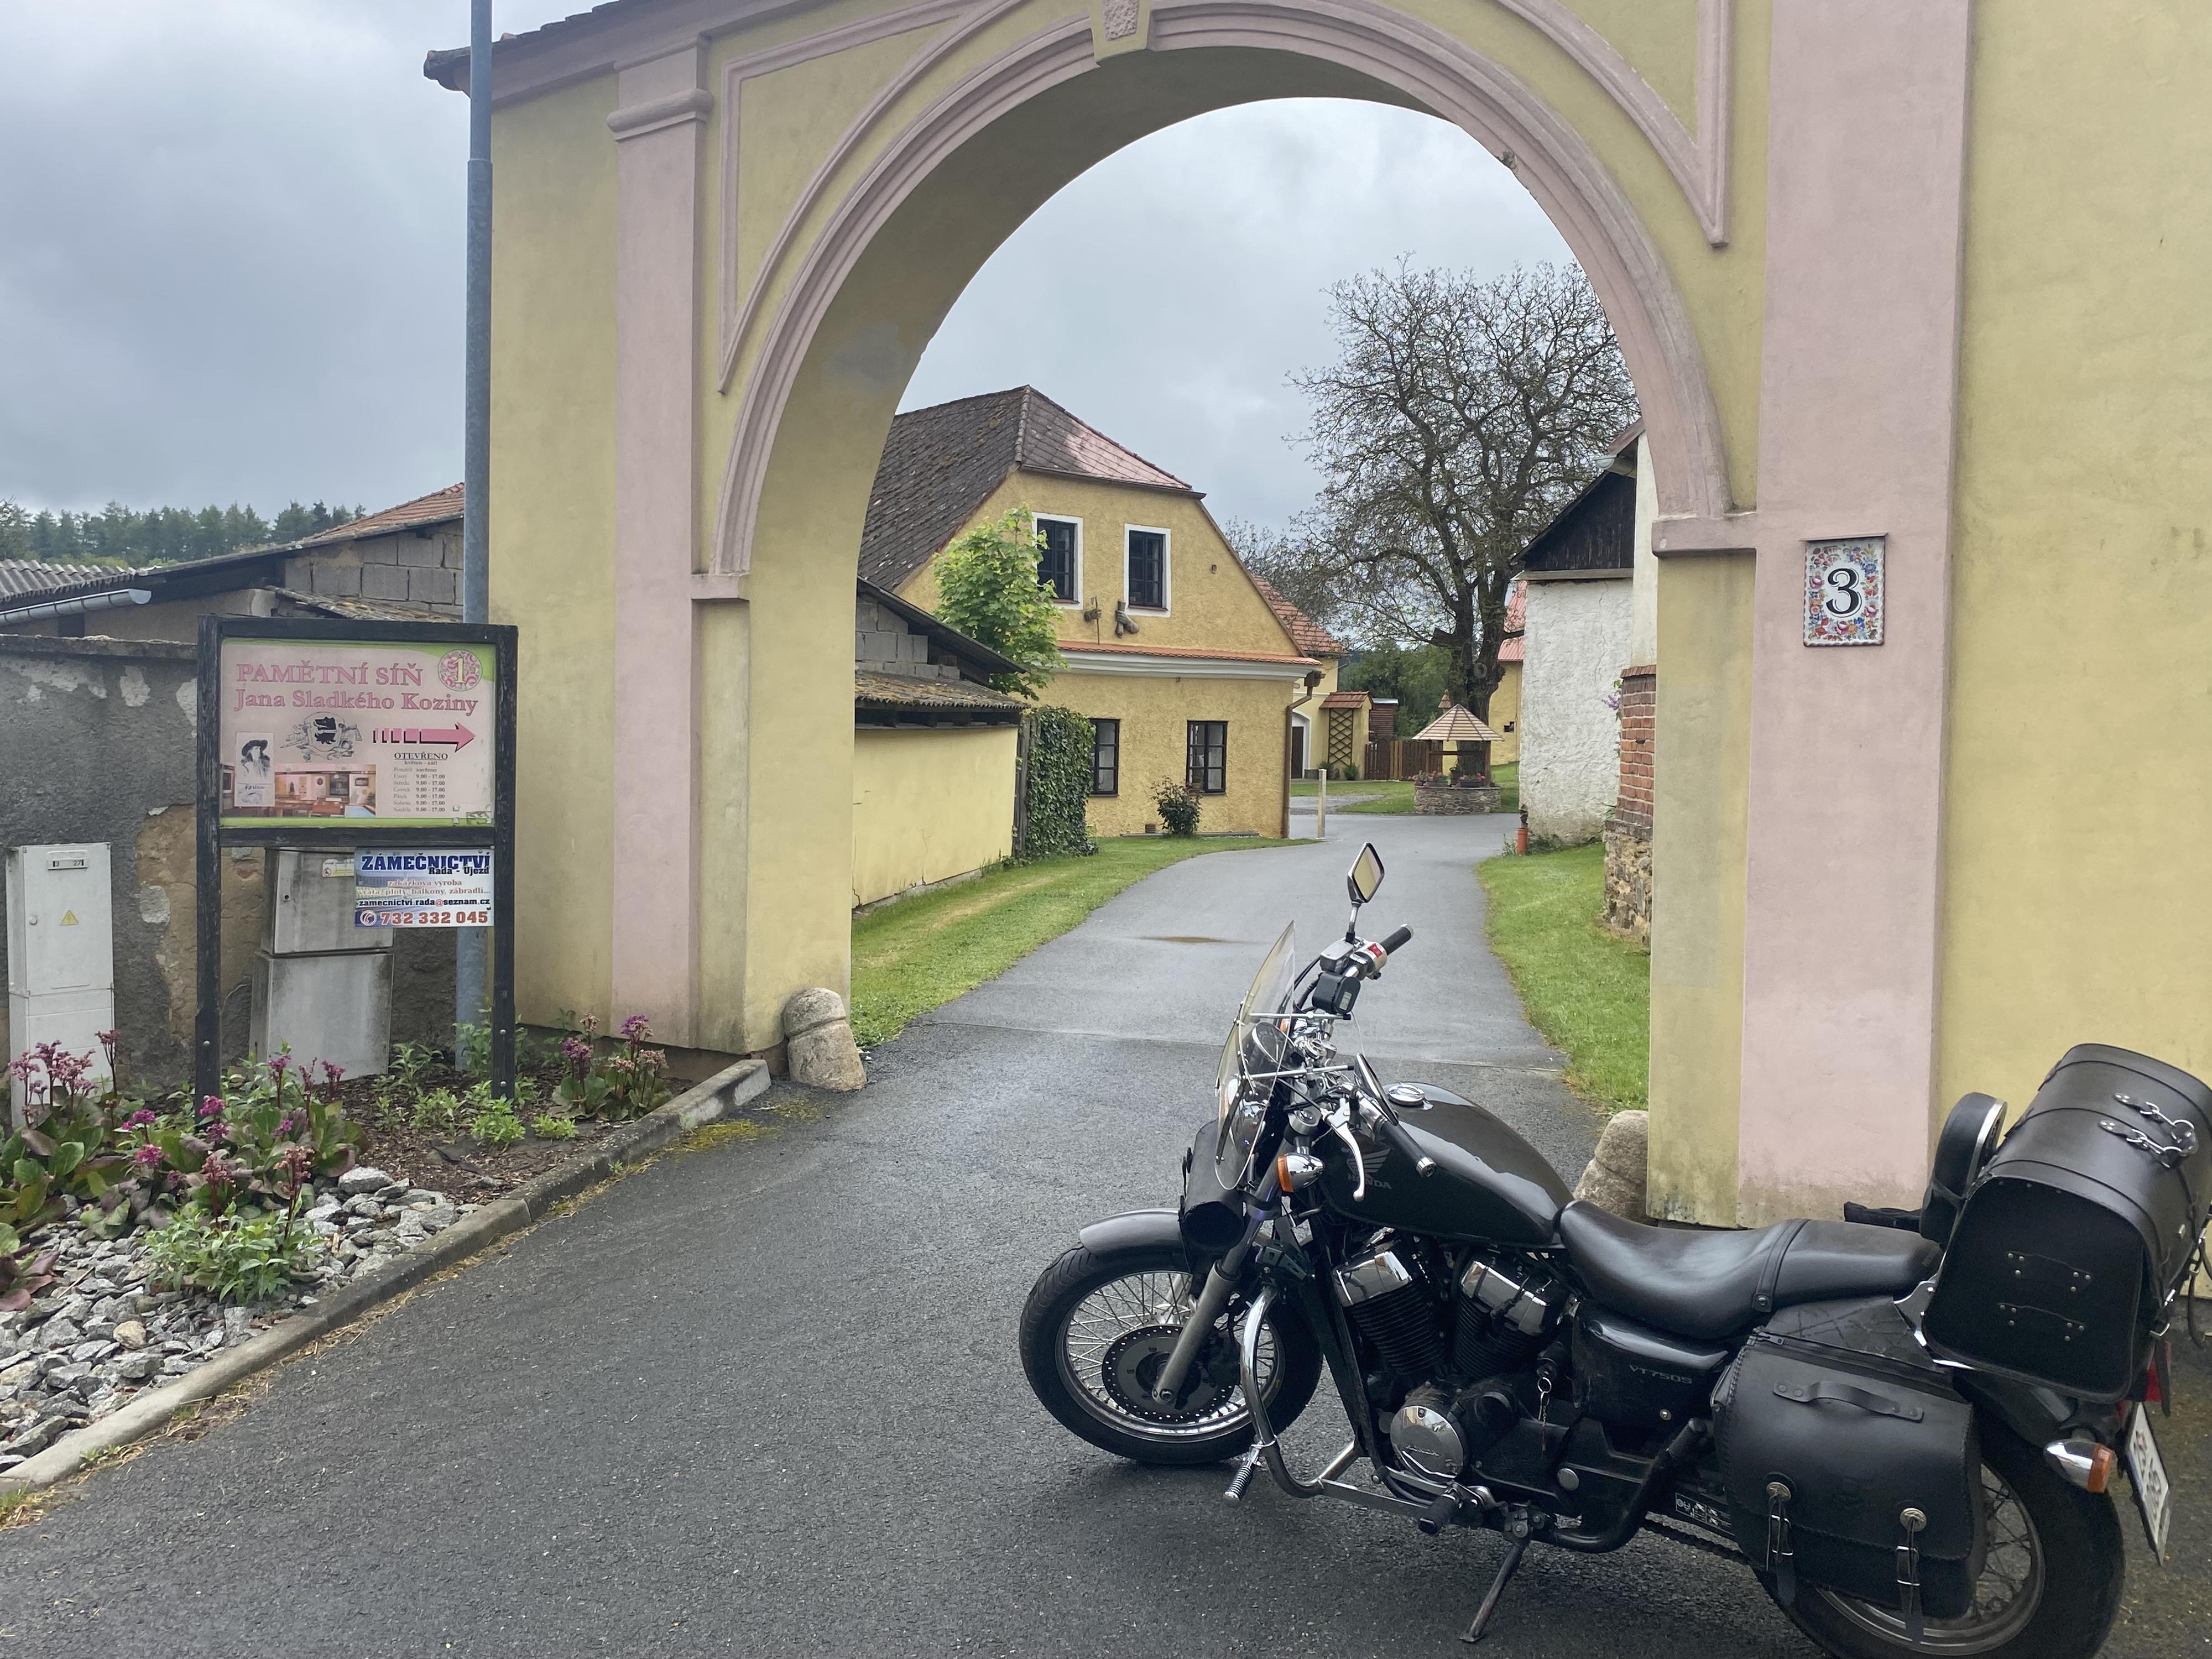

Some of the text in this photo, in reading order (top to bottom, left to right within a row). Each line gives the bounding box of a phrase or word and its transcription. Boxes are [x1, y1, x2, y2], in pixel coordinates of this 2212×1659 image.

[1826, 568, 1862, 618] 3
[237, 660, 422, 686] PAMĚTNÍ SÍŇ
[453, 656, 468, 684] 1
[233, 689, 479, 716] Jana Sladkého Koziny
[394, 751, 448, 760] OTEVŘENO
[362, 852, 491, 870] ZÁMEČNICTVÍ
[429, 867, 453, 875] Rada
[435, 879, 462, 888] výroba
[380, 911, 488, 925] 732 332 045
